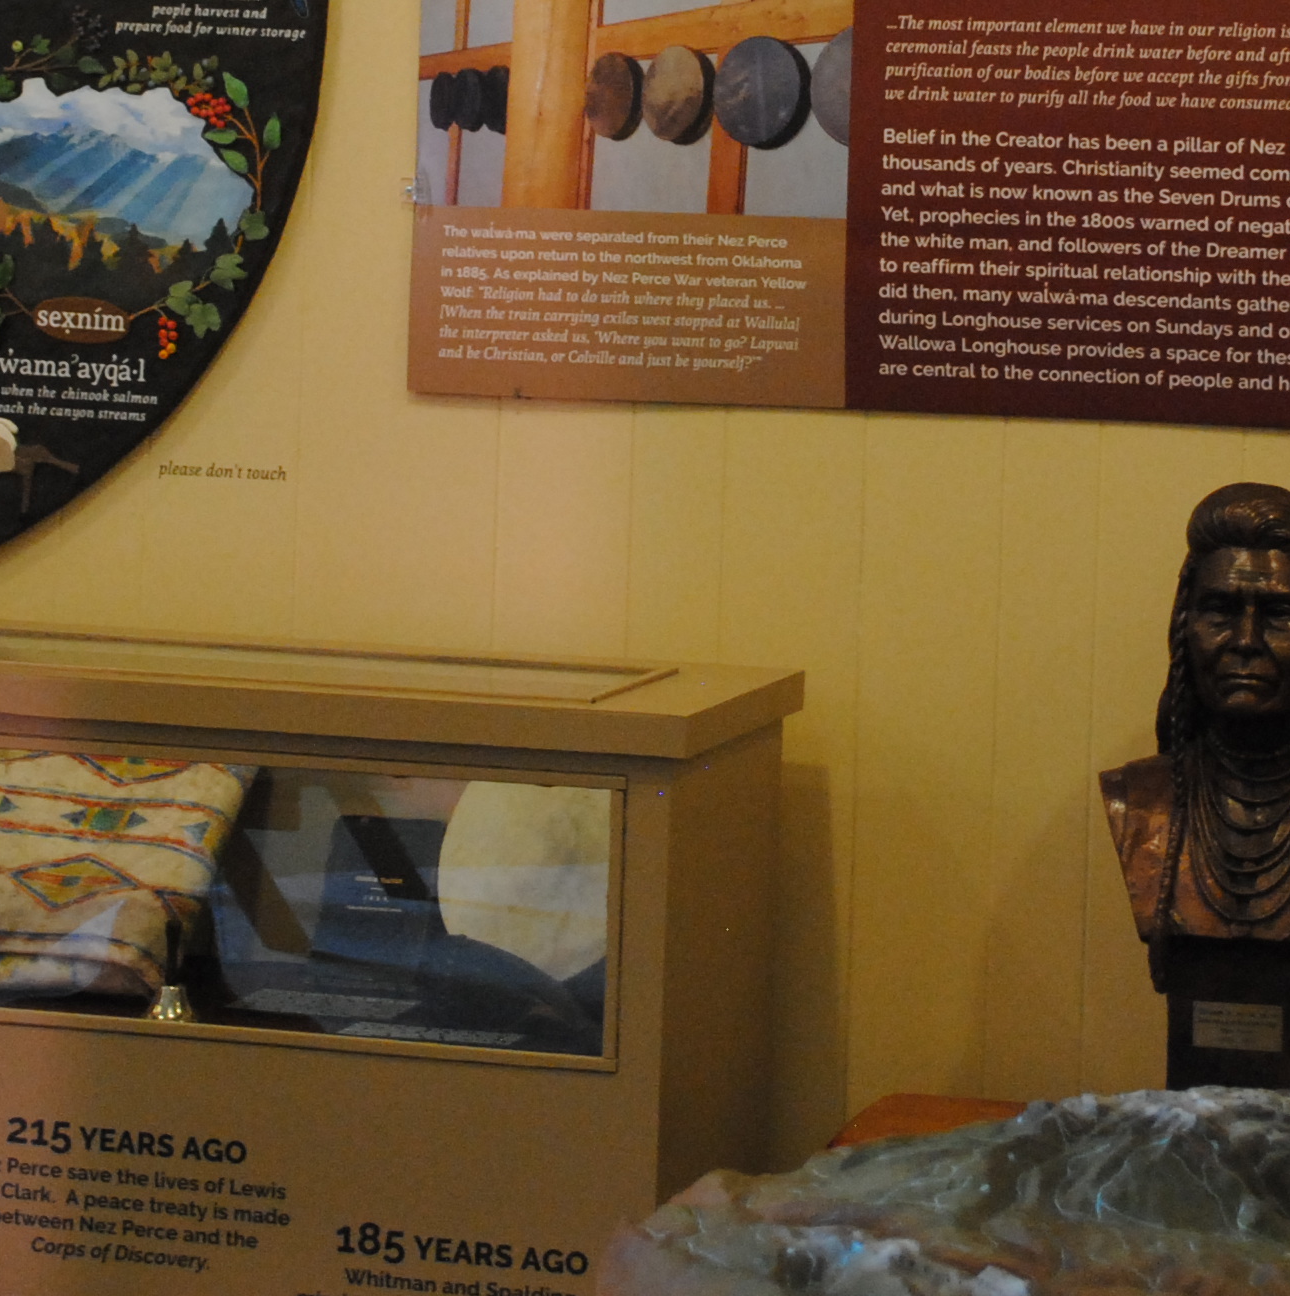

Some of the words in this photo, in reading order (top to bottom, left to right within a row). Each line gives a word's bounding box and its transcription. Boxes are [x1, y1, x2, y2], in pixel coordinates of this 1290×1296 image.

[114, 21, 163, 35] prepare
[162, 19, 193, 37] food
[192, 21, 214, 38] for
[215, 26, 259, 37] winter
[260, 27, 307, 42] storage
[883, 127, 937, 145] Belief
[939, 129, 957, 146] in
[960, 129, 992, 147] the
[995, 130, 1064, 149] Creator
[1067, 132, 1101, 150] has
[1105, 133, 1153, 152] been
[1156, 138, 1169, 152] a
[1172, 136, 1222, 156] pillar
[1225, 137, 1246, 155] of
[1249, 138, 1286, 156] Nez
[440, 265, 454, 277] in
[456, 265, 491, 281] 1885.
[492, 267, 511, 280] As
[512, 268, 579, 283] explained
[581, 269, 600, 286] by
[602, 271, 629, 285] Nez
[631, 271, 672, 286] Perce
[673, 273, 703, 287] War
[704, 275, 758, 288] veteran
[760, 276, 808, 291] Yellow
[158, 460, 203, 480] please
[204, 462, 243, 480] don't
[246, 465, 287, 482] touch
[6, 1116, 72, 1155] 215
[79, 1125, 175, 1159] YEARS
[181, 1136, 248, 1165] AGO
[30, 1236, 86, 1261] Corps
[89, 1242, 113, 1264] of
[113, 1244, 210, 1274] Discovery.
[335, 1223, 406, 1265] 185
[413, 1234, 514, 1269] YEARS
[520, 1246, 590, 1277] AGO
